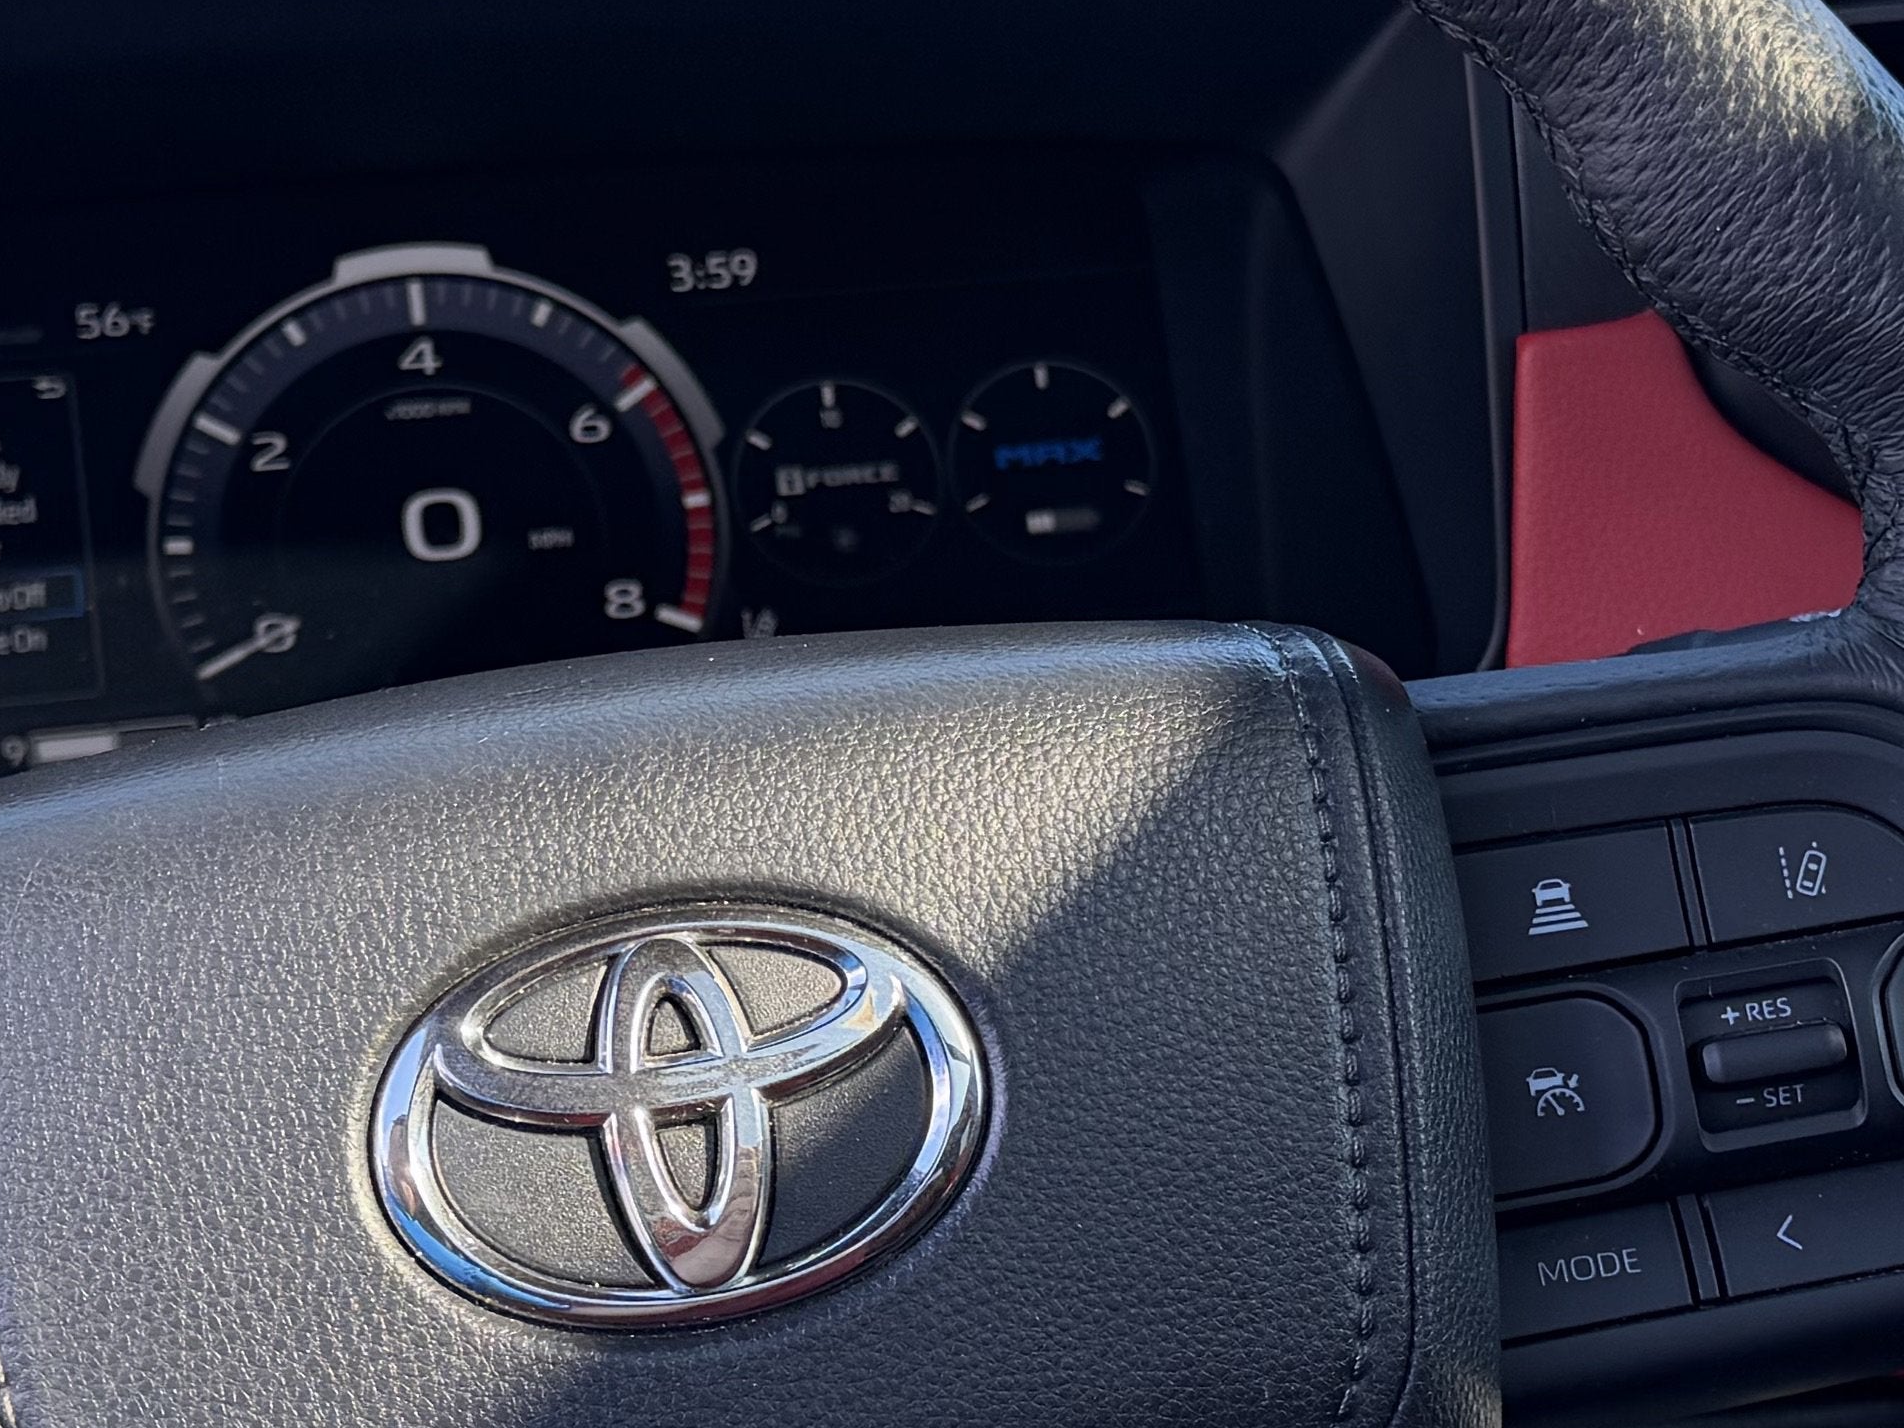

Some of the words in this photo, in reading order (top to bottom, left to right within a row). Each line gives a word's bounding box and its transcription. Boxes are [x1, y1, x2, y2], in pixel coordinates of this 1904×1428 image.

[667, 248, 759, 293] 3:59
[396, 337, 443, 375] 4
[568, 409, 613, 444] 6
[249, 433, 292, 472] 2
[400, 486, 482, 562] 0
[11, 579, 47, 610] Off
[603, 578, 644, 619] 8
[11, 623, 49, 654] On
[1763, 1083, 1806, 1109] SET
[1536, 1245, 1643, 1287] MODE
